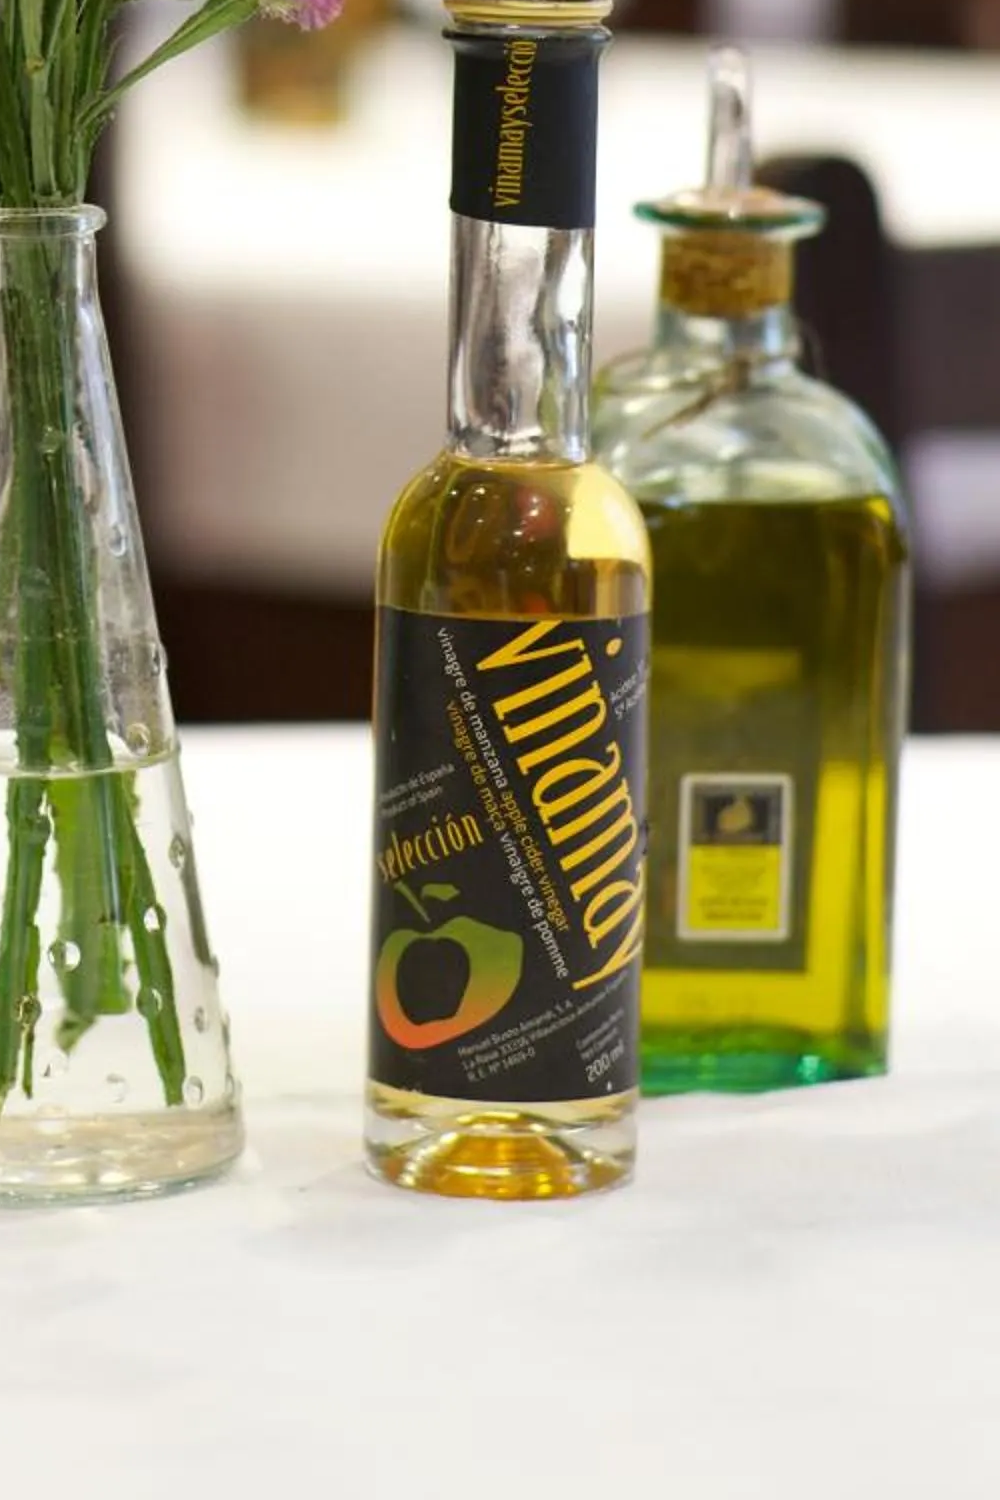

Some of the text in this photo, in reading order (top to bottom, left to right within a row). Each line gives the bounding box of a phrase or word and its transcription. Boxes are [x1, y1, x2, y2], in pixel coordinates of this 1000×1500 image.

[445, 701, 478, 761] vinagre
[437, 627, 571, 932] vinagre de manzana apple cider vinegar
[471, 763, 487, 786] de
[500, 831, 535, 897] vinaigre
[526, 896, 545, 920] de
[532, 920, 571, 980] pomme
[585, 1053, 611, 1083] 200
